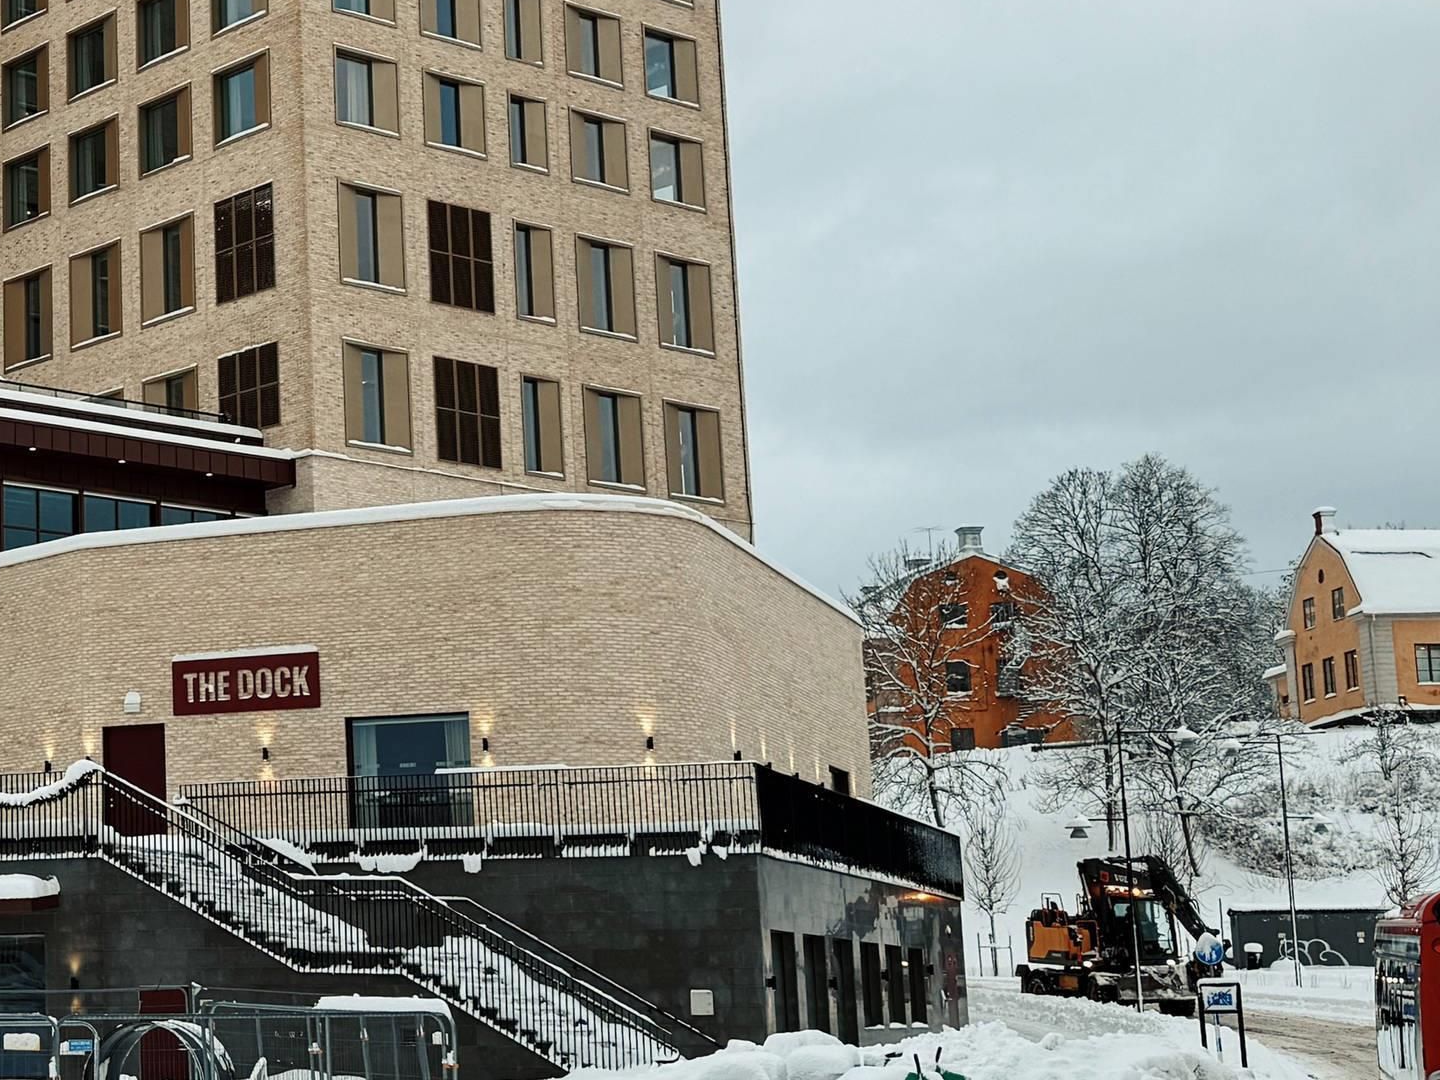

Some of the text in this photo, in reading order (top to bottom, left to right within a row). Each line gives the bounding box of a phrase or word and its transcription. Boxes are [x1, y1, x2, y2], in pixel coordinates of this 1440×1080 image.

[183, 665, 311, 703] THE DOCK
[1113, 873, 1138, 885] VOLO
